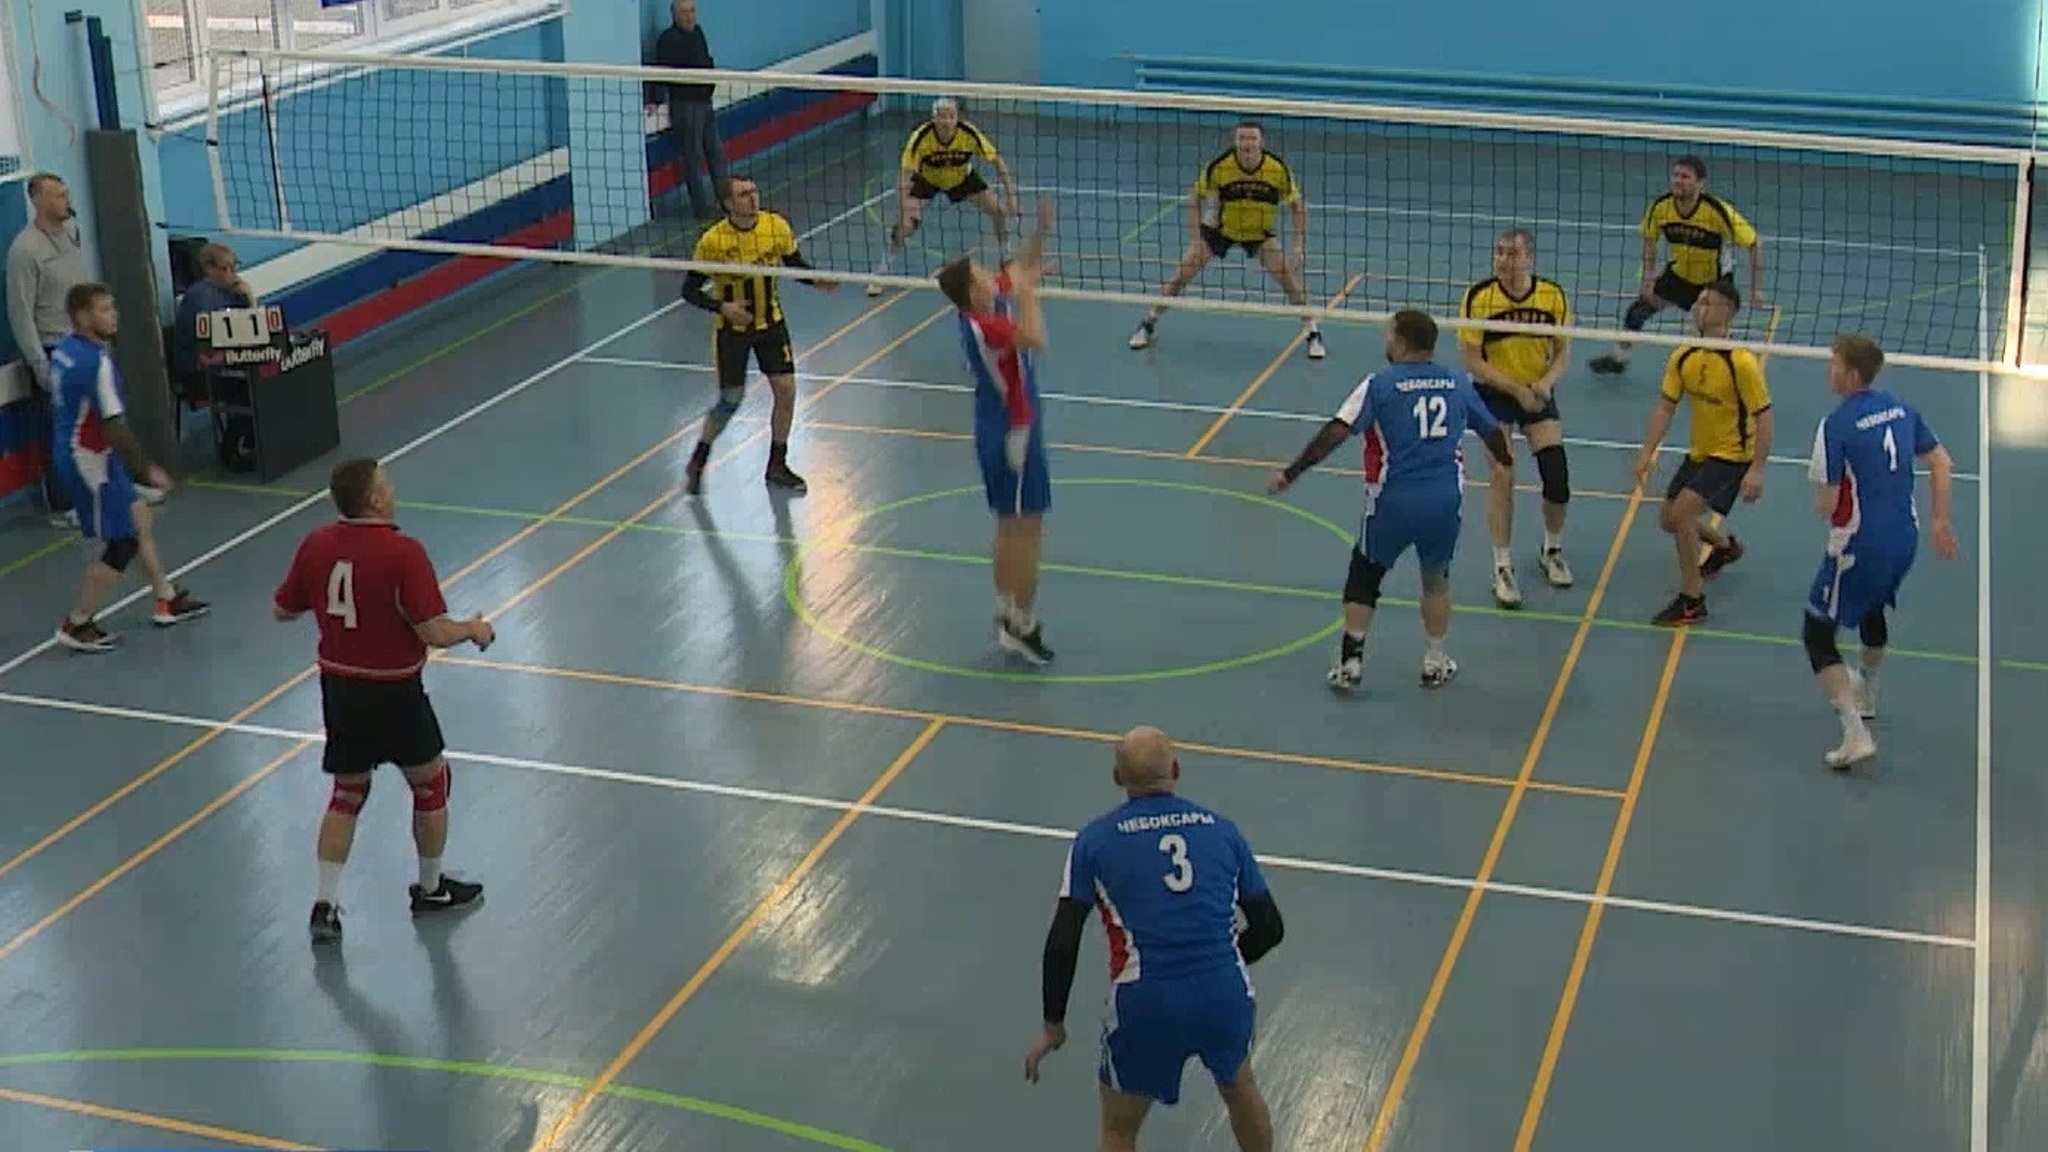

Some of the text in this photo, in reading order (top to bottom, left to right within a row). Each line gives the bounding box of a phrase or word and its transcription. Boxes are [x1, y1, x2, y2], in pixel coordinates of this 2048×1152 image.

[226, 346, 281, 364] Butterfly
[1413, 395, 1448, 439] 12
[1883, 424, 1898, 473] 1
[327, 559, 358, 629] 4
[1117, 812, 1216, 833] ЧЕБОКСАРЫ
[1158, 833, 1193, 892] 3
